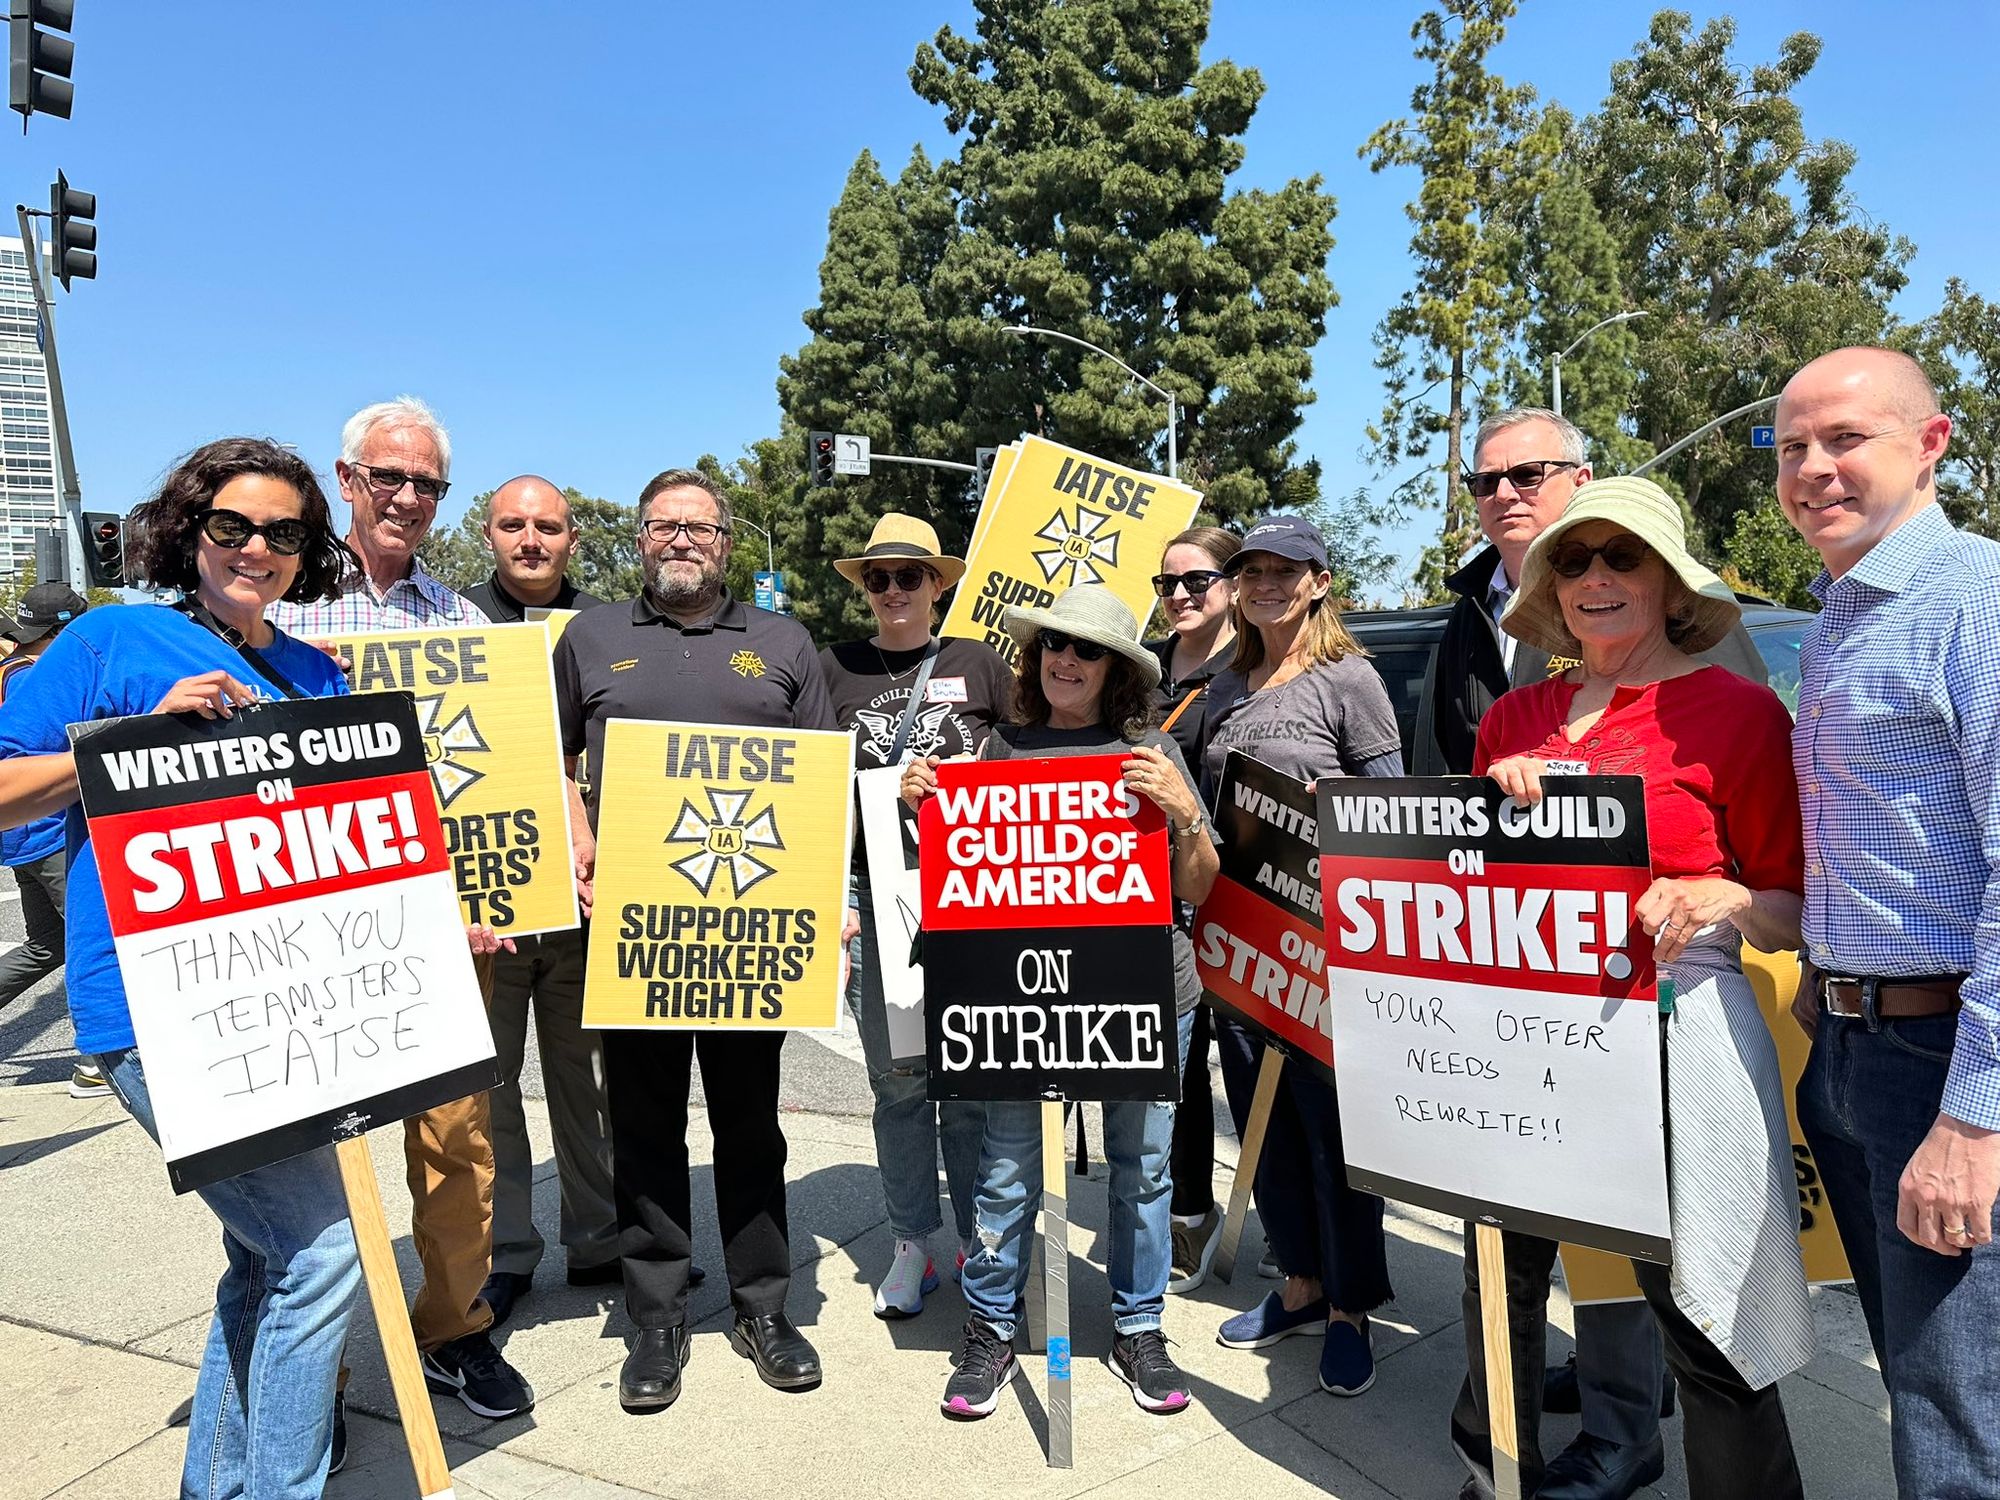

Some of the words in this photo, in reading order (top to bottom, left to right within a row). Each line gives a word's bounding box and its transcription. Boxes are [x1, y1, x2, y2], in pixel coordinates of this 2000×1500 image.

[1053, 457, 1157, 520] IATSE
[981, 570, 1056, 609] SUPP
[339, 636, 489, 692] IATSE
[948, 713, 975, 753] AMERI
[101, 732, 295, 792] WRITERS
[299, 722, 402, 766] GUILD
[665, 732, 797, 783] IATSE
[256, 777, 295, 805] ON
[936, 778, 1141, 826] WRITERS
[439, 808, 540, 854] ORTS
[1331, 796, 1490, 837] WRITERS
[1498, 796, 1627, 839] GUILD
[124, 790, 427, 914] STRIKE!
[946, 823, 1089, 867] GUILD
[1091, 831, 1138, 862] OF
[1306, 857, 1321, 880] O
[1448, 848, 1485, 876] ON
[454, 847, 541, 893] ERS'
[937, 863, 1155, 909] AMERICA
[1255, 862, 1324, 919] AMER
[141, 917, 310, 992] THANK
[322, 894, 404, 956] YOU
[619, 903, 816, 945] SUPPORTS
[1336, 877, 1633, 980] STRIKE!
[617, 942, 815, 982] WORKERS'
[1016, 948, 1073, 995] ON
[1280, 930, 1326, 976] ON
[191, 956, 425, 1038] TEAMSTERS
[645, 981, 783, 1020] RIGHTS
[1198, 922, 1333, 1041] STRIK
[941, 1003, 1164, 1072] STRIKE
[1365, 988, 1456, 1034] YOUR
[1496, 1009, 1610, 1053] OFFER
[207, 1002, 429, 1098] IATSE
[1407, 1048, 1500, 1080] NEEDS
[1542, 1067, 1557, 1093] A
[1395, 1094, 1562, 1144] REWRITE!!
